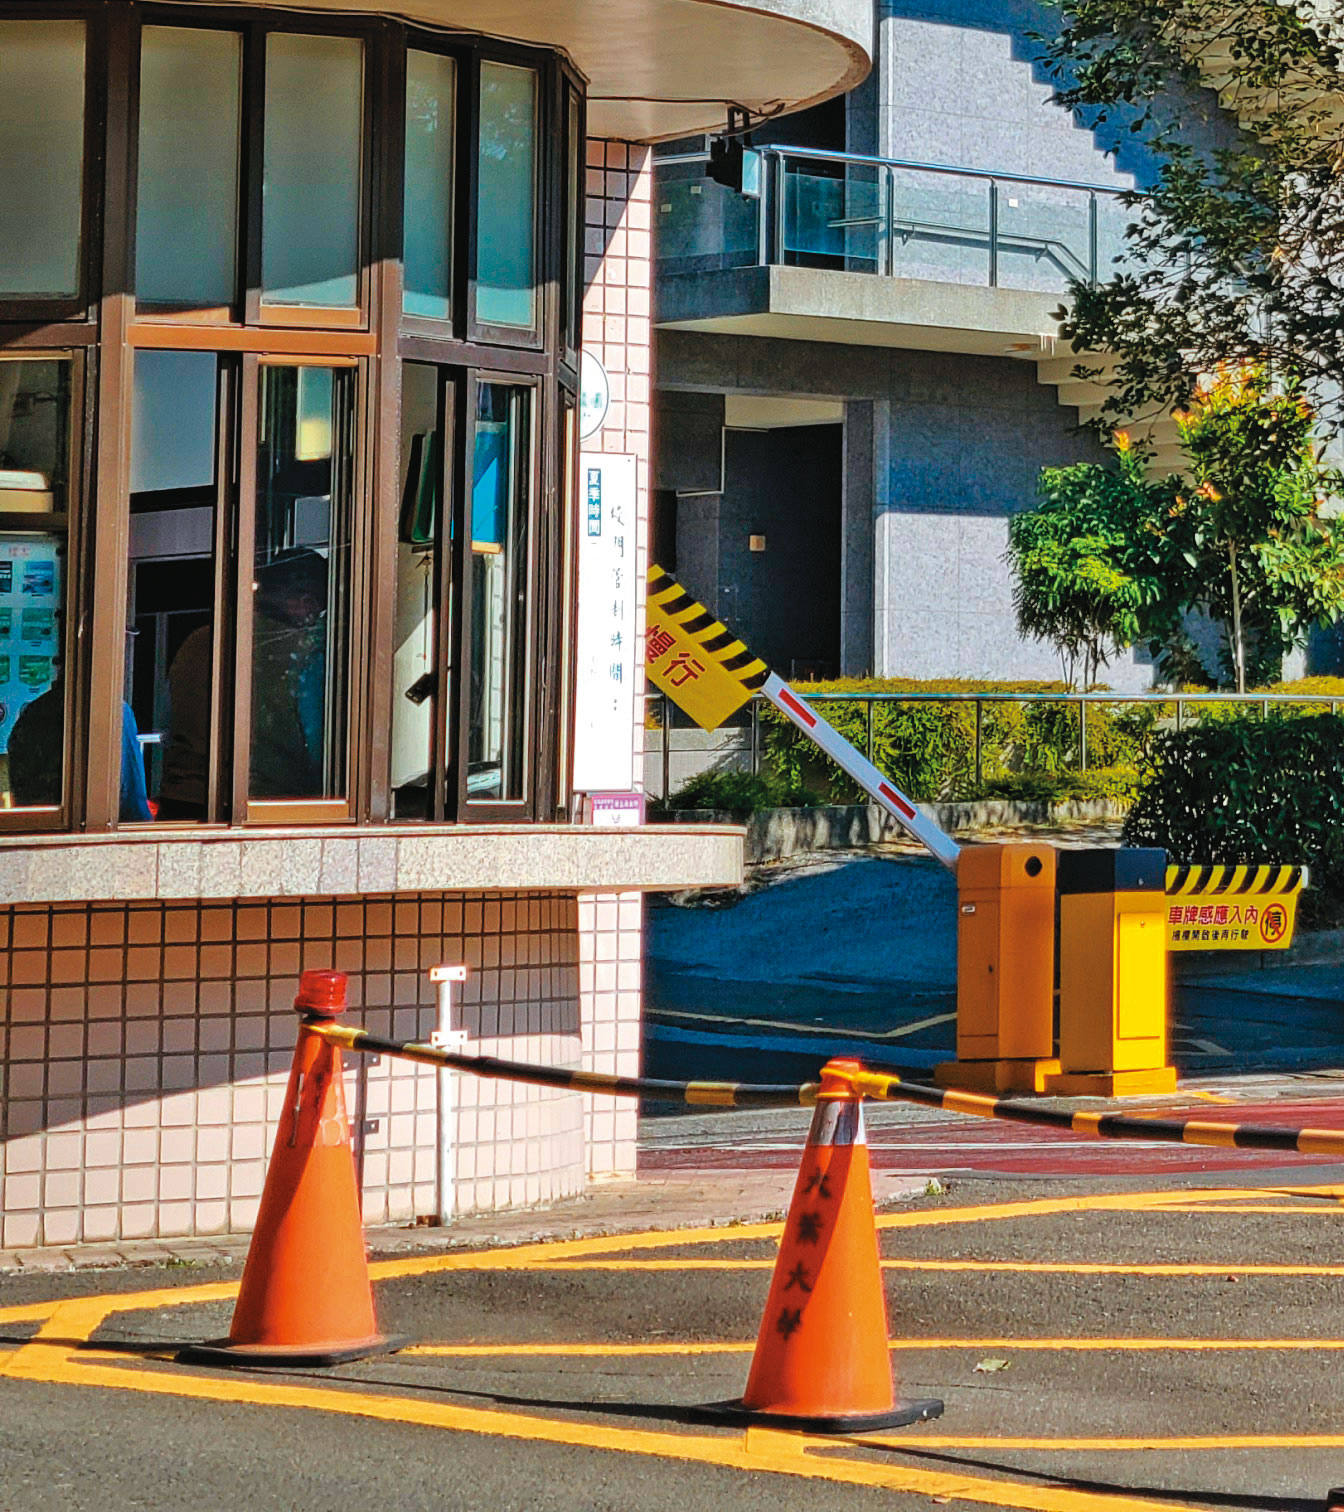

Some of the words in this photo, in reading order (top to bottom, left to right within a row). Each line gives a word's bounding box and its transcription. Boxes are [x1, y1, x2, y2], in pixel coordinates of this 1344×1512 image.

[645, 623, 707, 688] 慢行
[1168, 904, 1259, 926] 車牌感應入內
